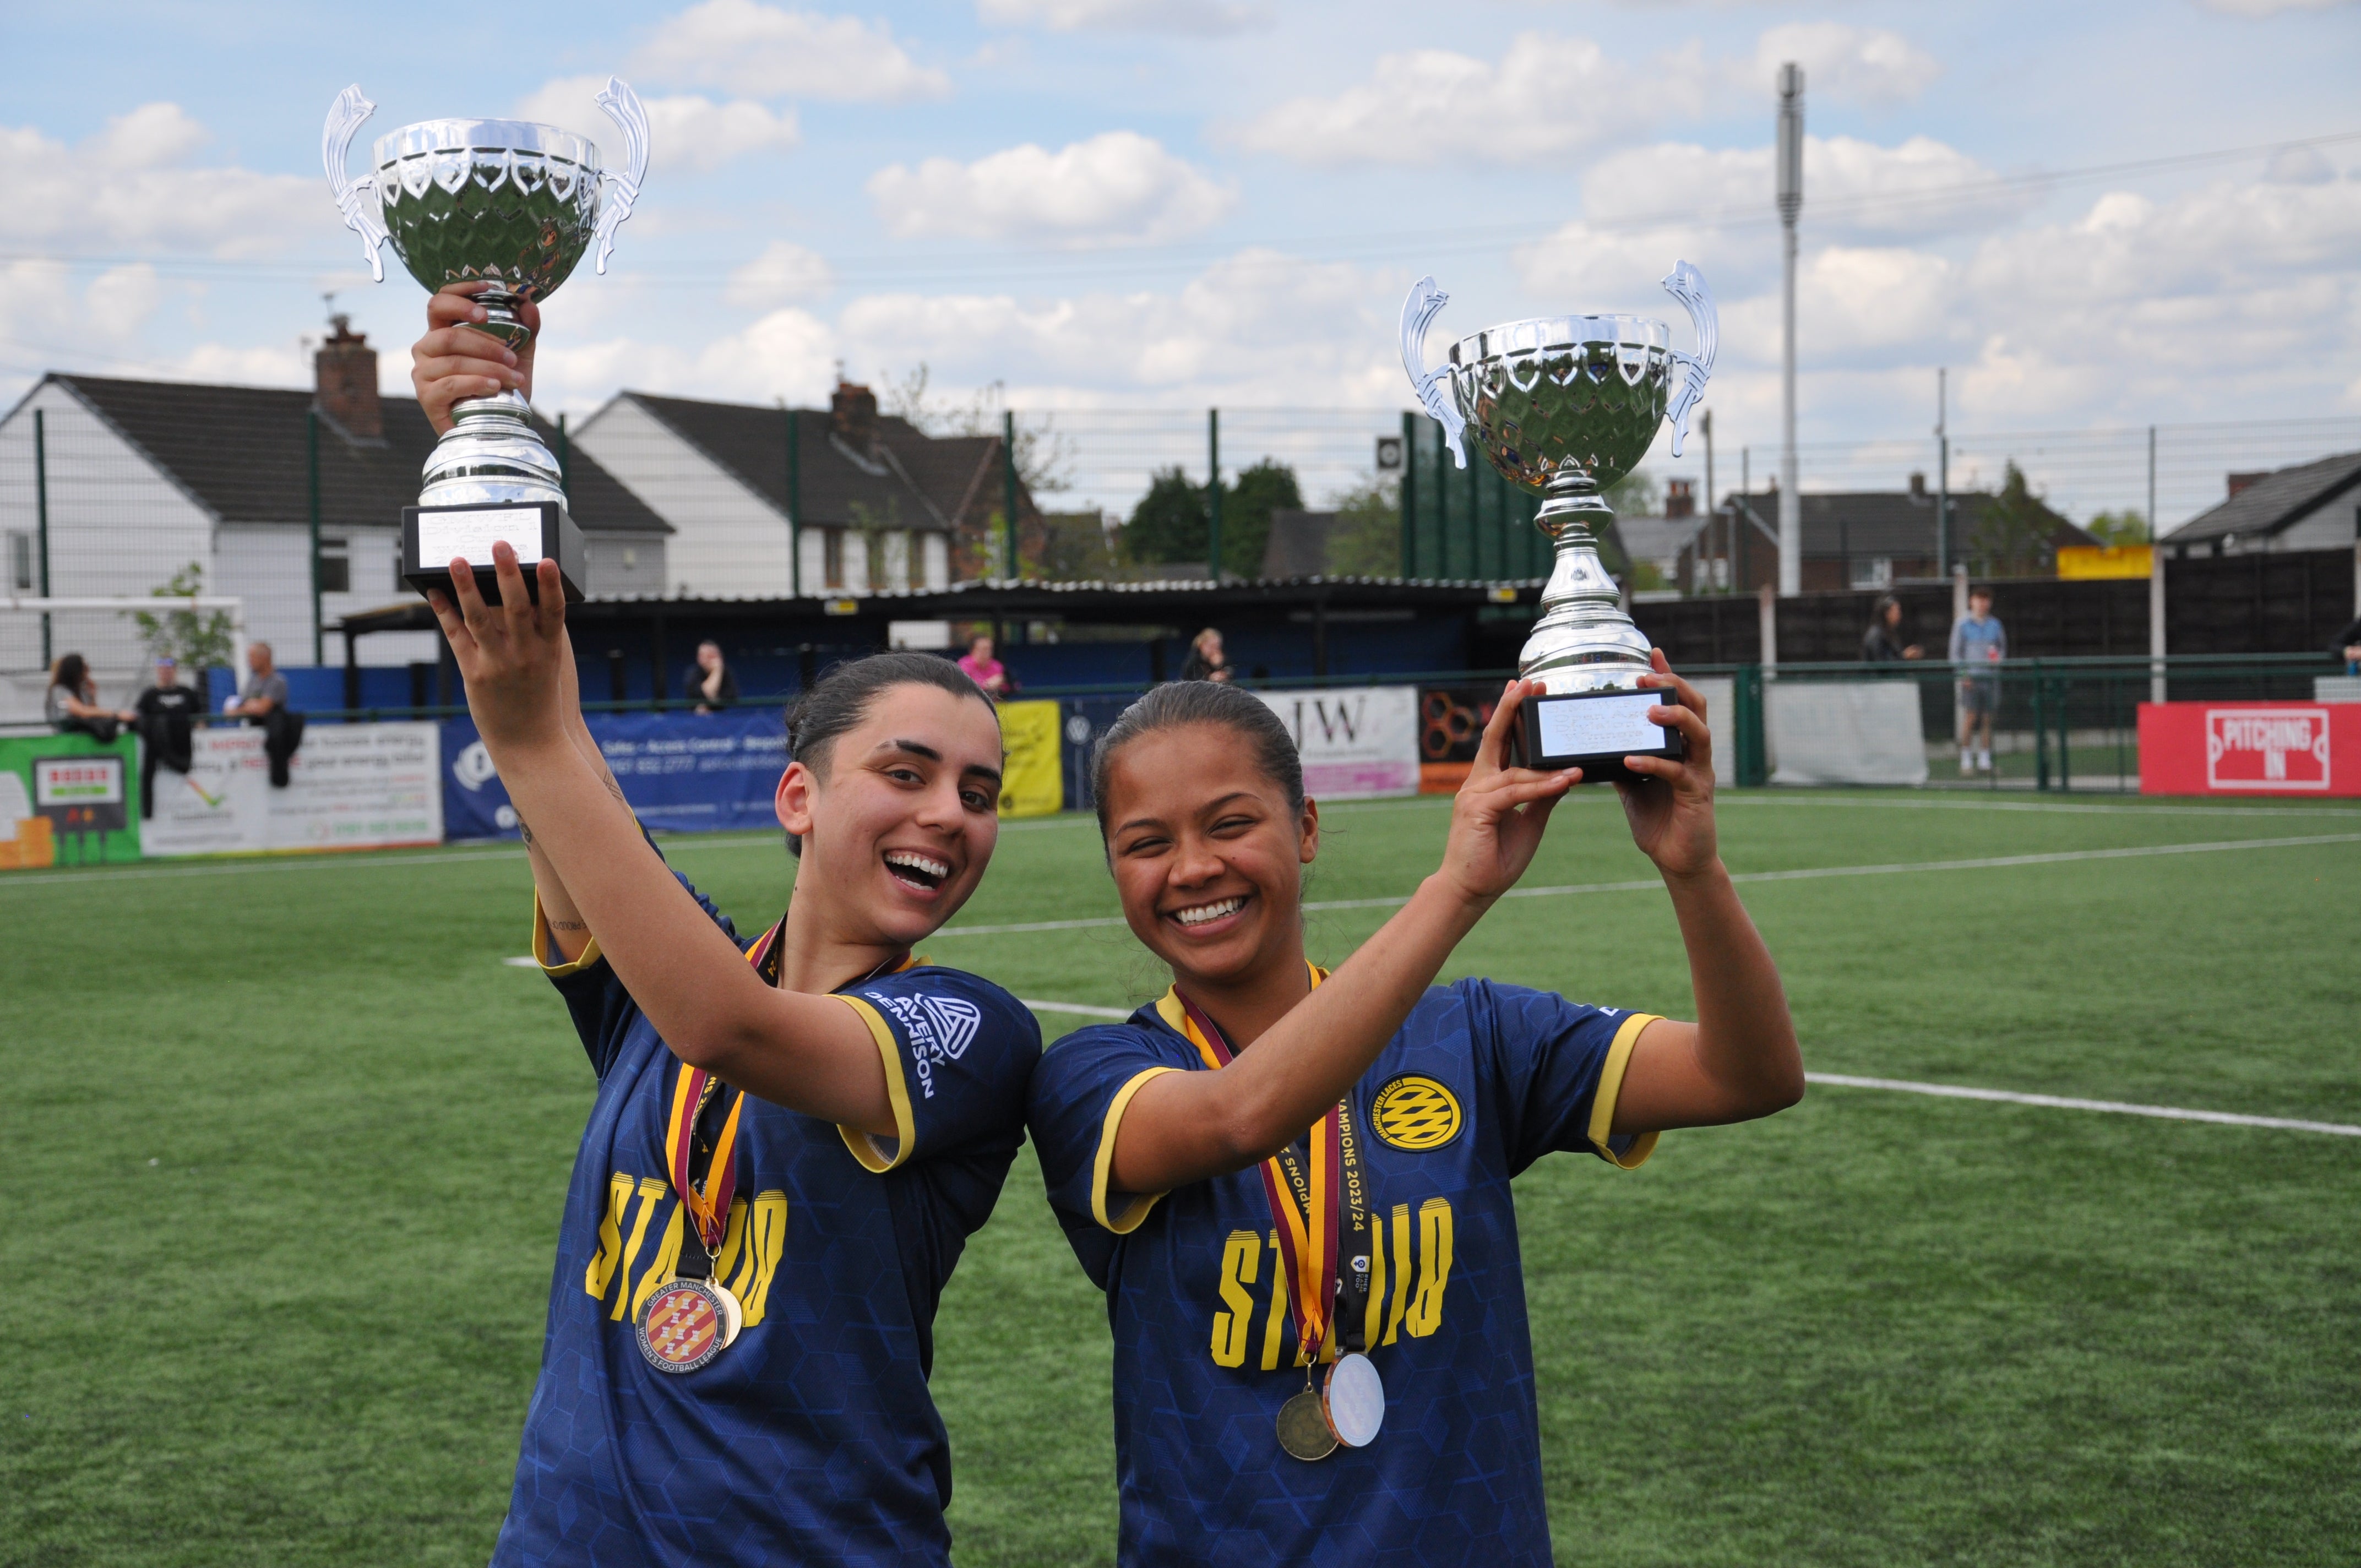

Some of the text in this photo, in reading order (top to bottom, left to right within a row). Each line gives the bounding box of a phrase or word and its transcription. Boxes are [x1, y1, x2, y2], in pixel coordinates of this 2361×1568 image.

[421, 524, 519, 535] Division
[432, 544, 528, 554] Winns
[2223, 718, 2312, 751] PITCHING
[2264, 750, 2287, 780] IN
[864, 992, 934, 1099] DENNISON
[893, 997, 945, 1066] AVERY
[1373, 1080, 1403, 1140] MANCHESTER LACES
[1339, 1099, 1365, 1232] AMPIONS 2023/24
[647, 1282, 723, 1316] GREATER MANCHESTER
[638, 1327, 722, 1371] WOMEN'S FOOTBALL LEAGUE
